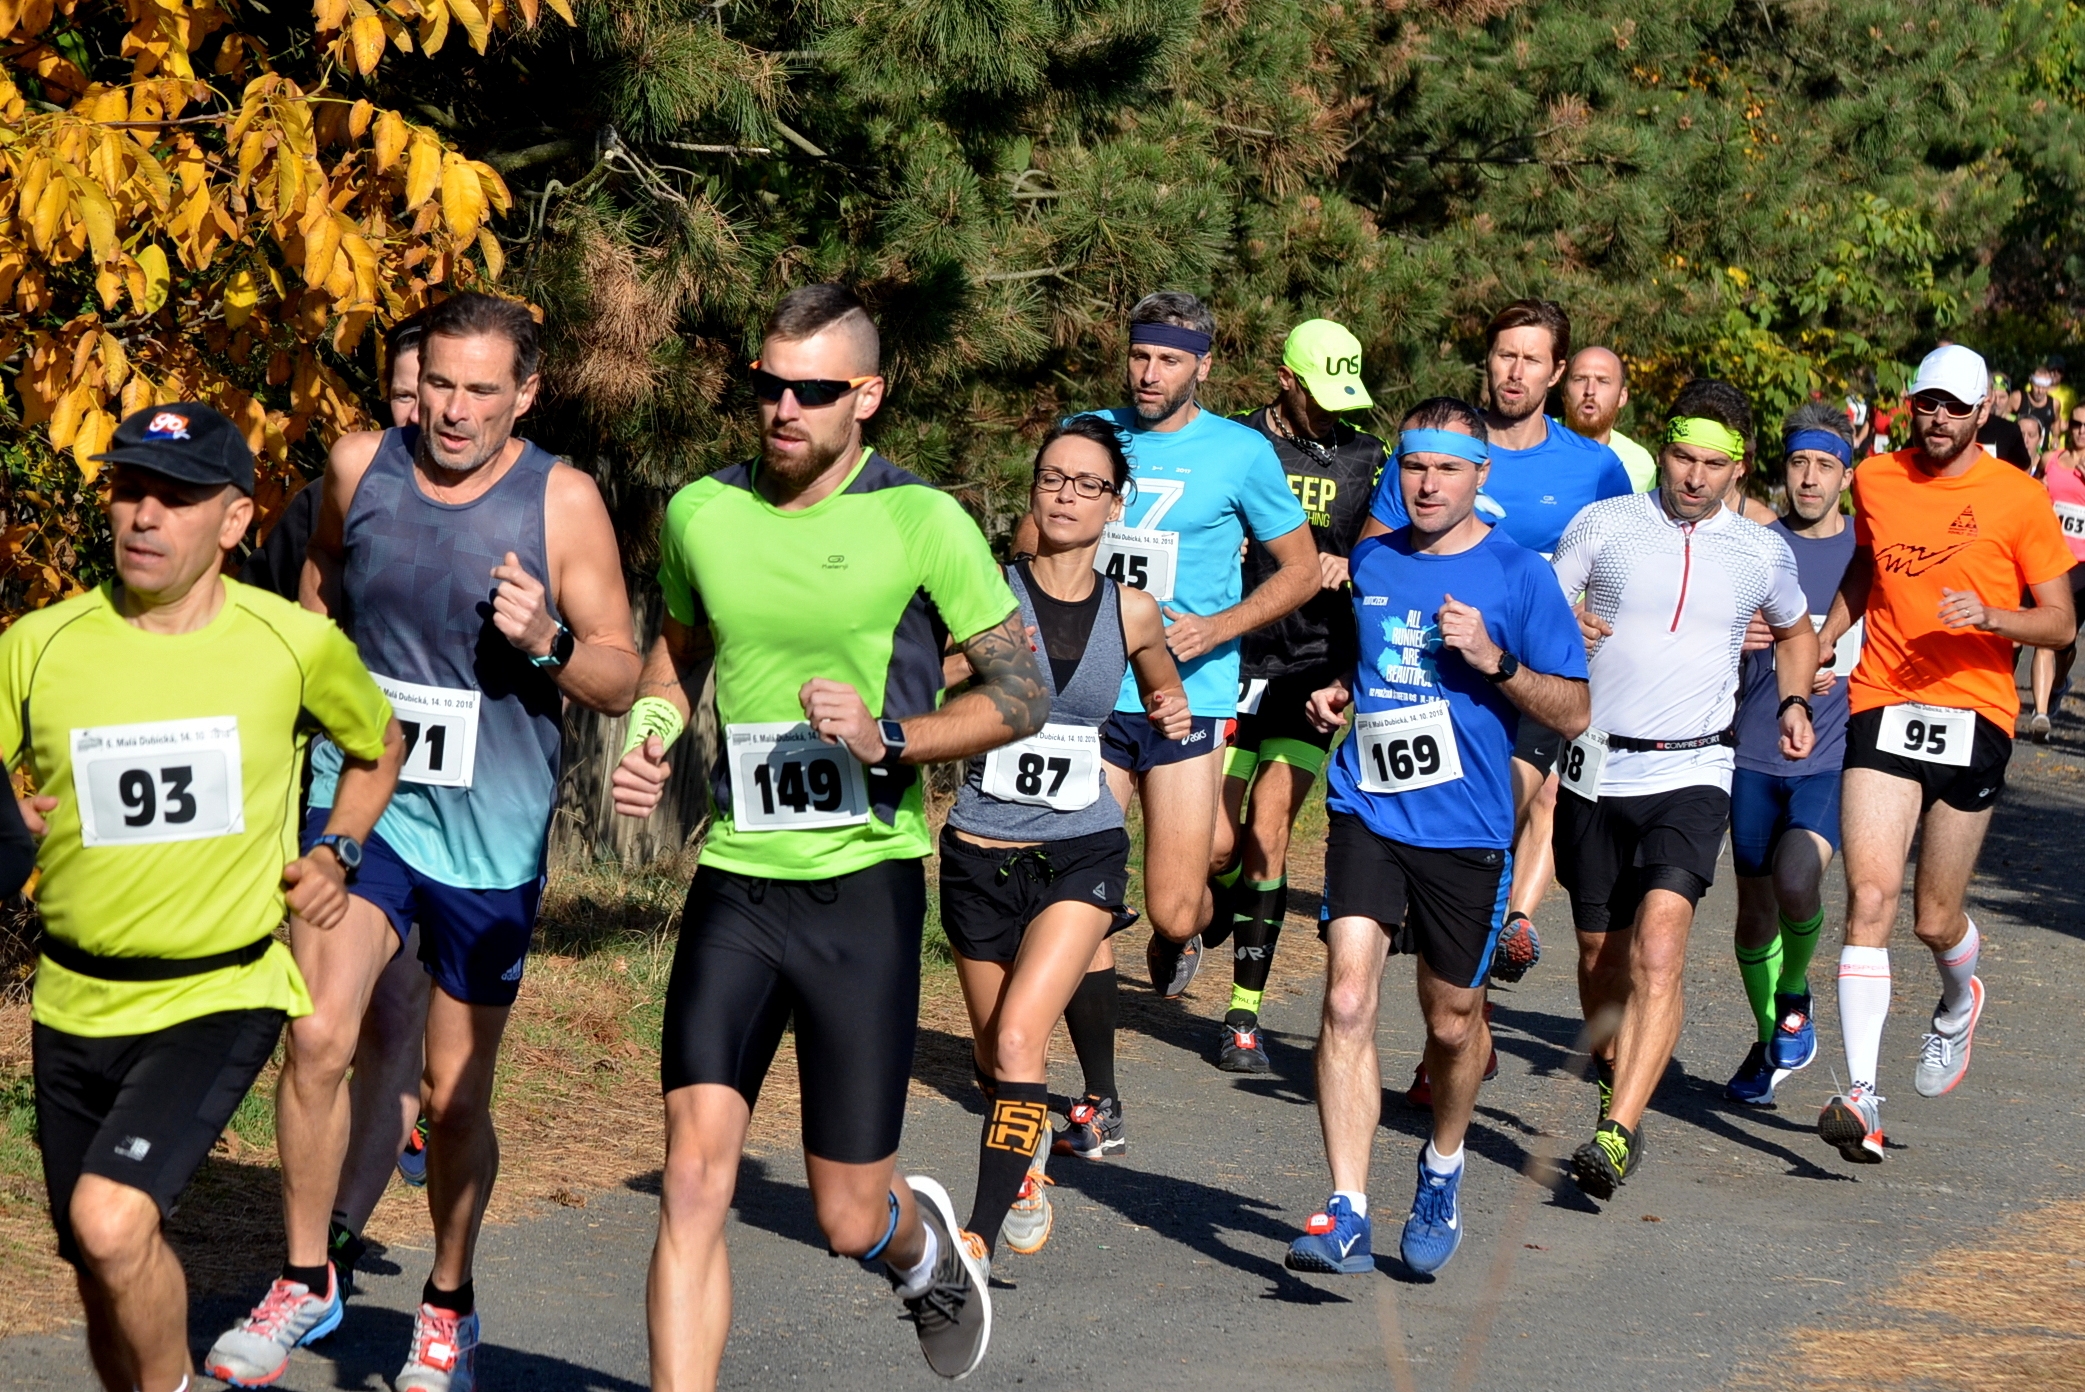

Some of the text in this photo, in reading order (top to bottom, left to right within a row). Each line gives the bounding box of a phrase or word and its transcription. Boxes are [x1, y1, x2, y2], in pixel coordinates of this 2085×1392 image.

[1106, 552, 1149, 591] 45
[1406, 609, 1422, 629] ALL
[1401, 647, 1421, 667] ARE
[384, 687, 398, 699] Malá
[399, 692, 430, 706] Dubická,
[455, 700, 474, 709] 2018
[1904, 719, 1947, 755] 95
[1016, 752, 1072, 797] 87
[1372, 734, 1441, 782] 169
[119, 765, 197, 828] 93
[754, 758, 842, 814] 149
